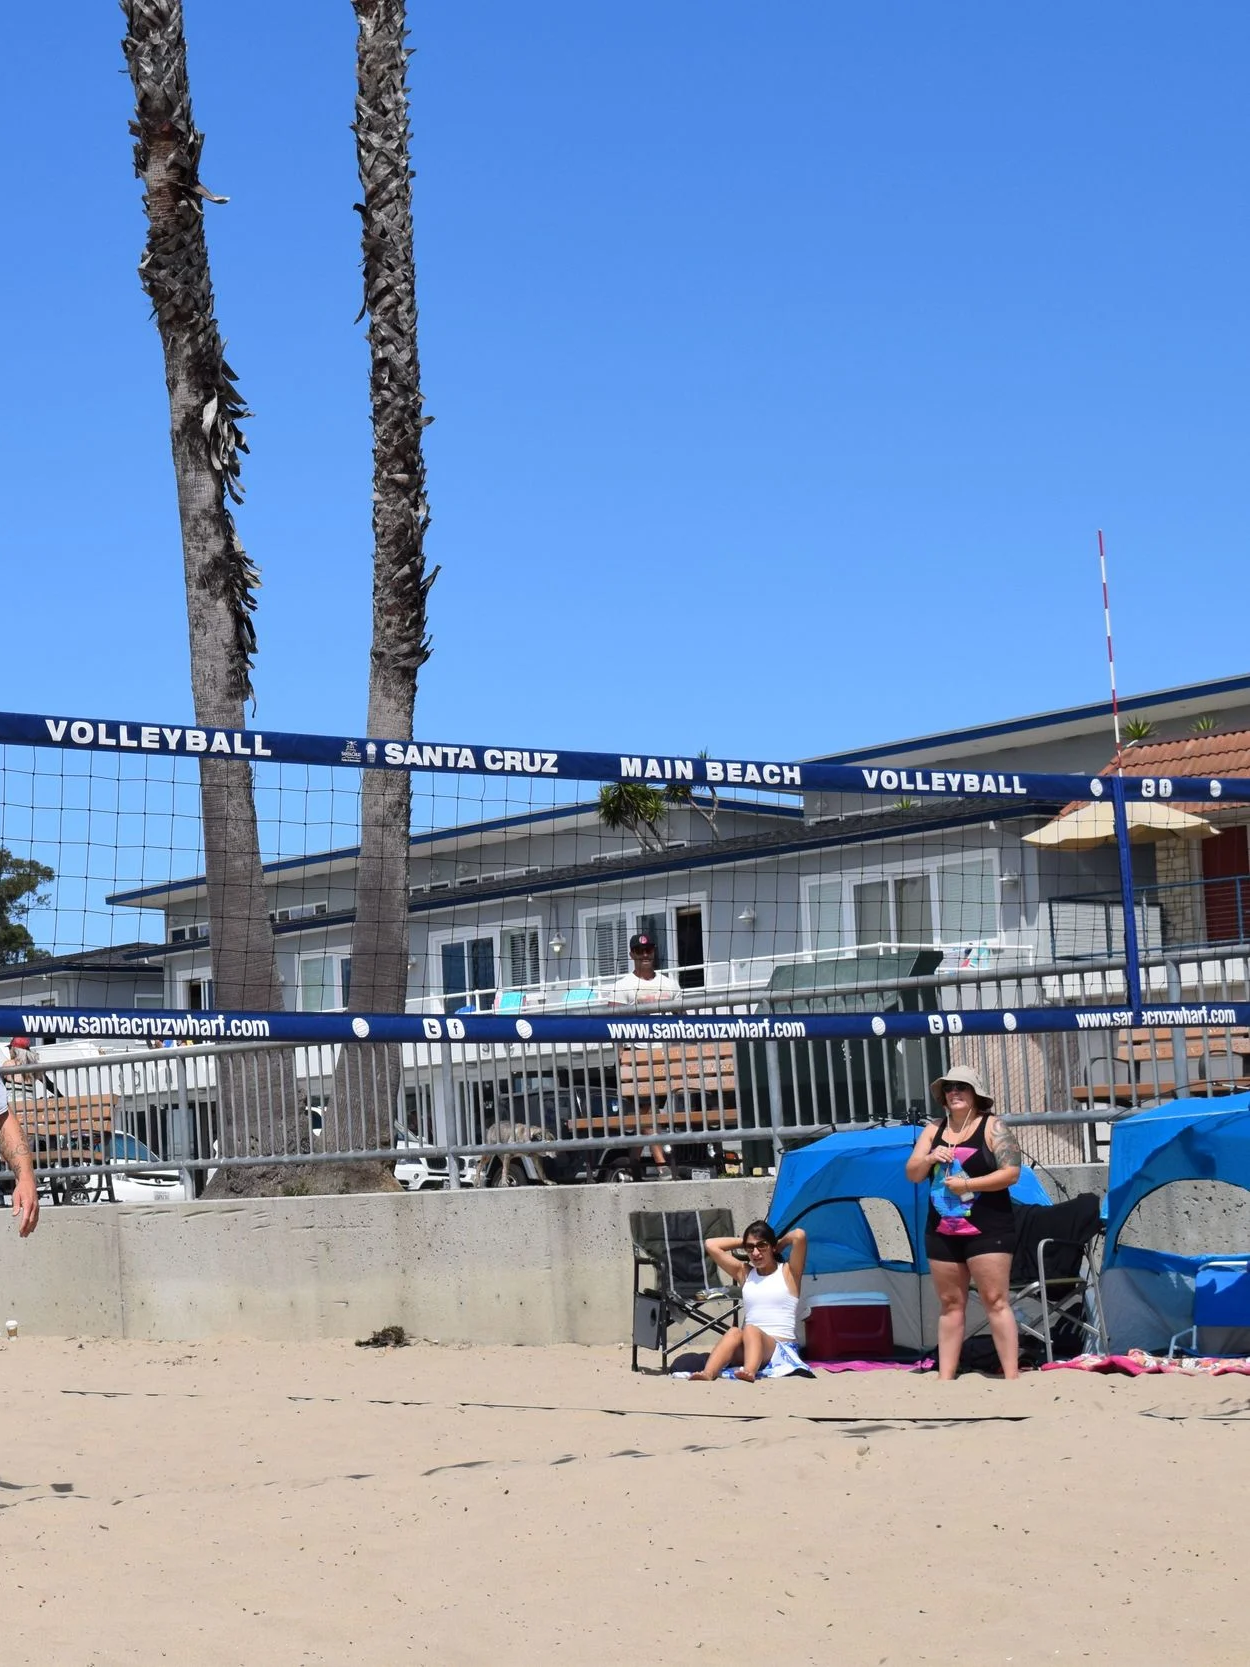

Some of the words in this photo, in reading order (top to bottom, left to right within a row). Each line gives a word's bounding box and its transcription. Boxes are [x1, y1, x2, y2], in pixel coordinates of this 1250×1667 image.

[45, 719, 272, 756] VOLLEYBALL
[384, 742, 476, 769] SANTA
[483, 749, 558, 774] CRUZ
[620, 757, 693, 780] MAIN
[705, 761, 801, 785] BEACH
[861, 769, 1027, 794] VOLLEYBALL
[22, 1013, 270, 1037] www.santacruzwharf.com
[606, 1018, 806, 1039] www.santacruzwharf.com
[1075, 1006, 1237, 1029] www.sanacruzwharf.com
